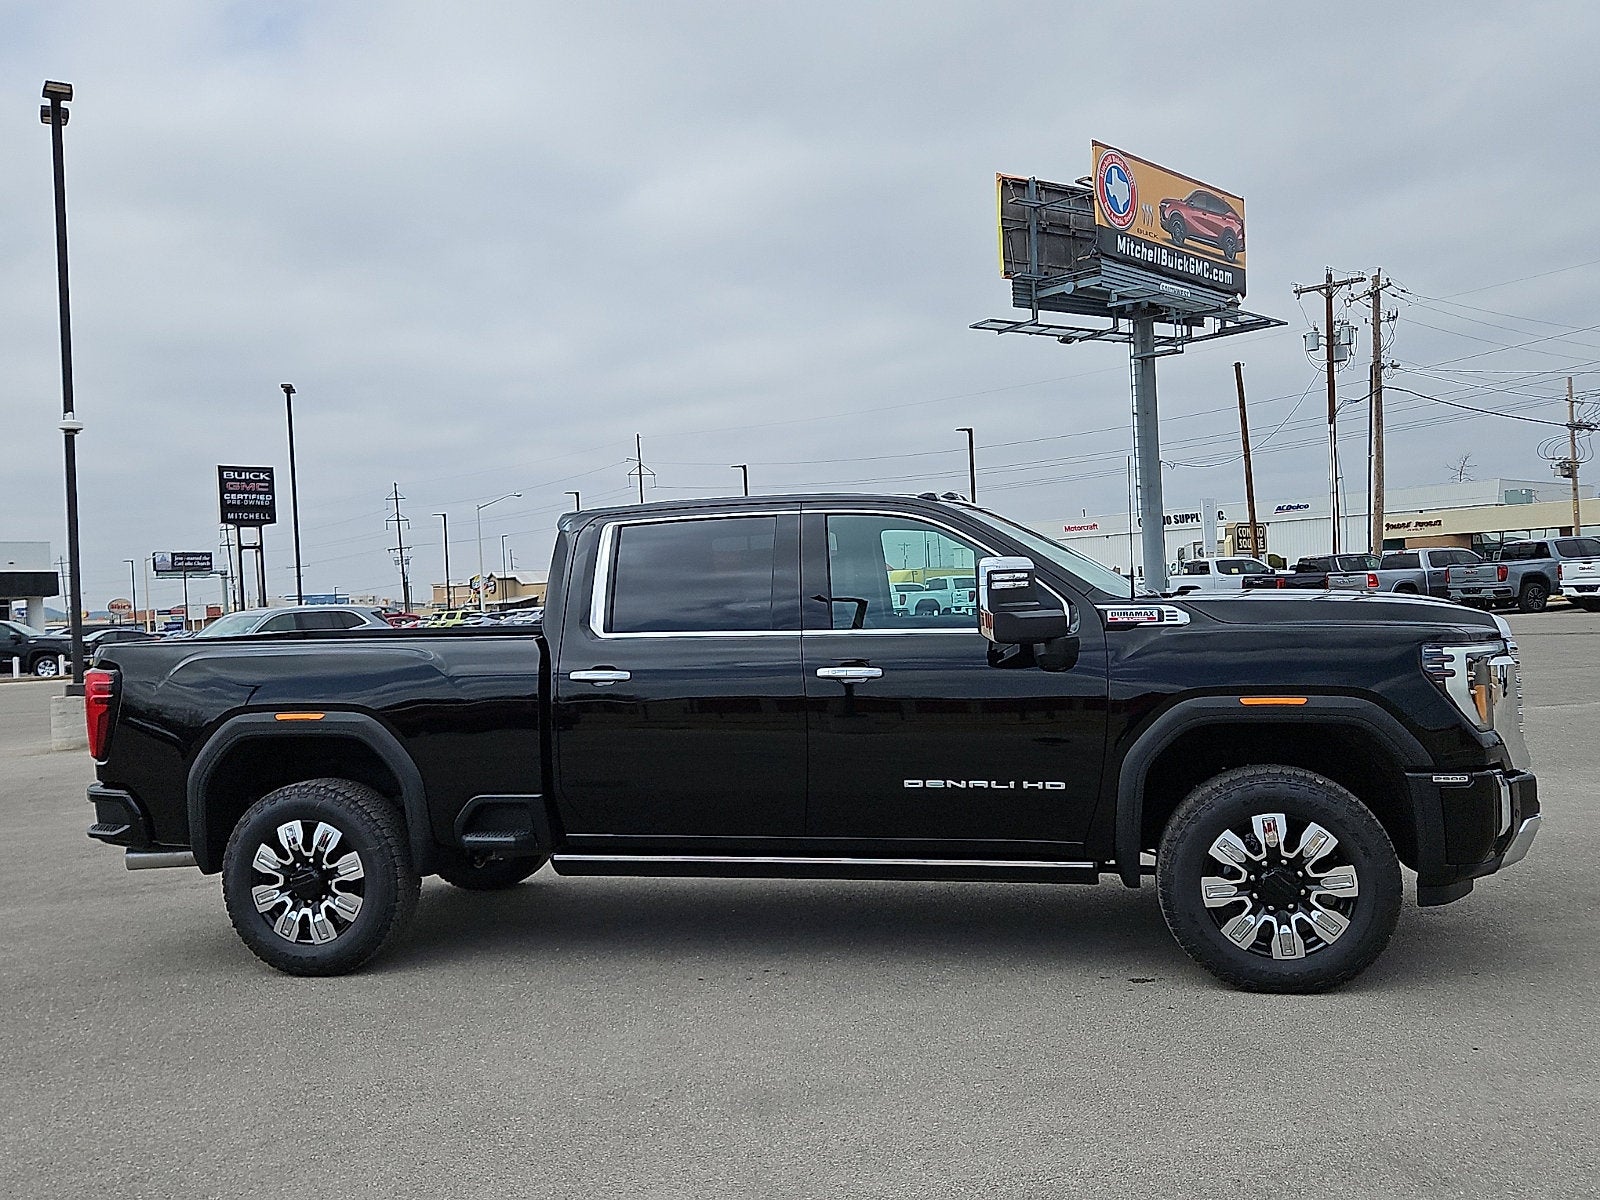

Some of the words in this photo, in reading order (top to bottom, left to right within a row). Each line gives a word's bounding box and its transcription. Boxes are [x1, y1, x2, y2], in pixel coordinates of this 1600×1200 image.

[1137, 227, 1159, 239] BUICK
[1117, 234, 1233, 285] MitchellBuickGMC.com
[223, 471, 271, 480] BUICK
[226, 482, 269, 491] GMC
[223, 493, 273, 501] CERTIFIED
[227, 512, 271, 520] MITCHELL
[1173, 511, 1202, 525] SUPPL
[1064, 523, 1099, 533] Motorcraft
[903, 779, 1015, 789] DENALI
[1022, 781, 1066, 790] HD
